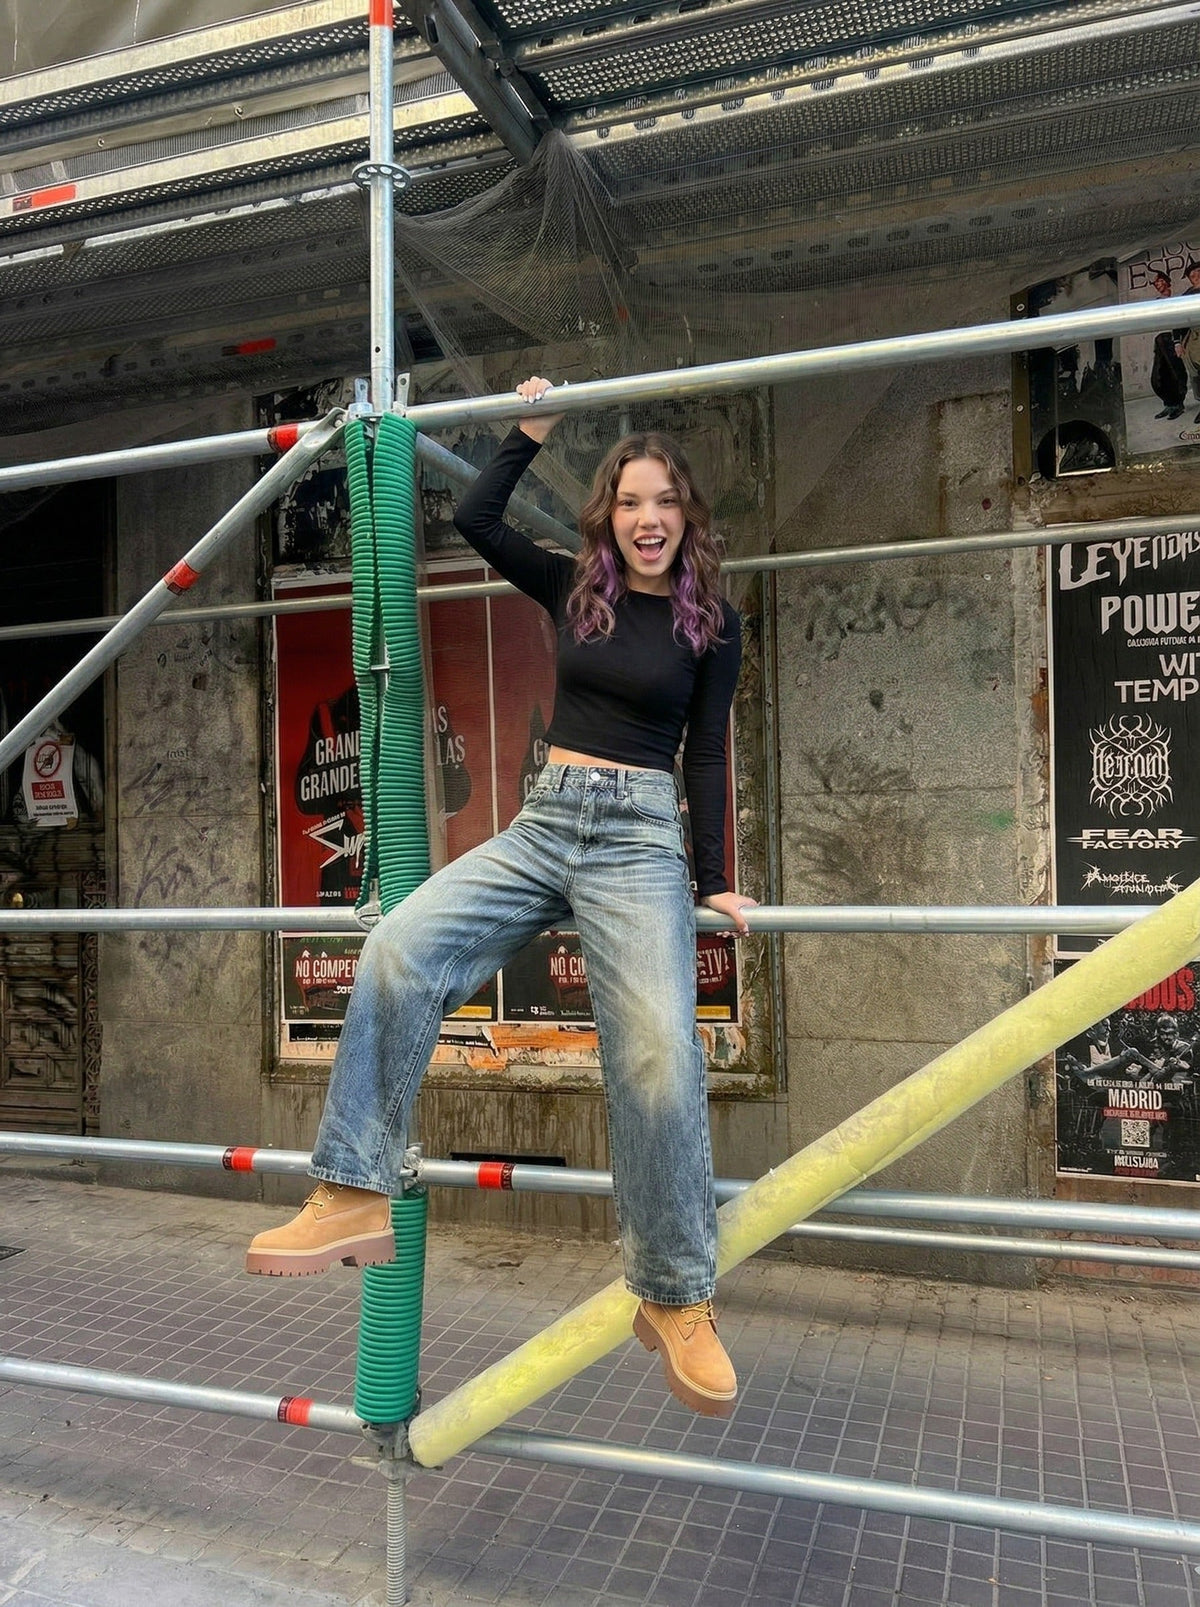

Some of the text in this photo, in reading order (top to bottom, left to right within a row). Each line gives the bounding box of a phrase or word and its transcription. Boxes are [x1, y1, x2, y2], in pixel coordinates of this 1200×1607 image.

[1114, 678, 1199, 703] TEMP
[1081, 828, 1184, 841] FEAR
[1081, 840, 1184, 850] FACTORY
[295, 959, 310, 978] NO
[550, 956, 566, 976] NO
[1107, 1088, 1163, 1110] MADRID
